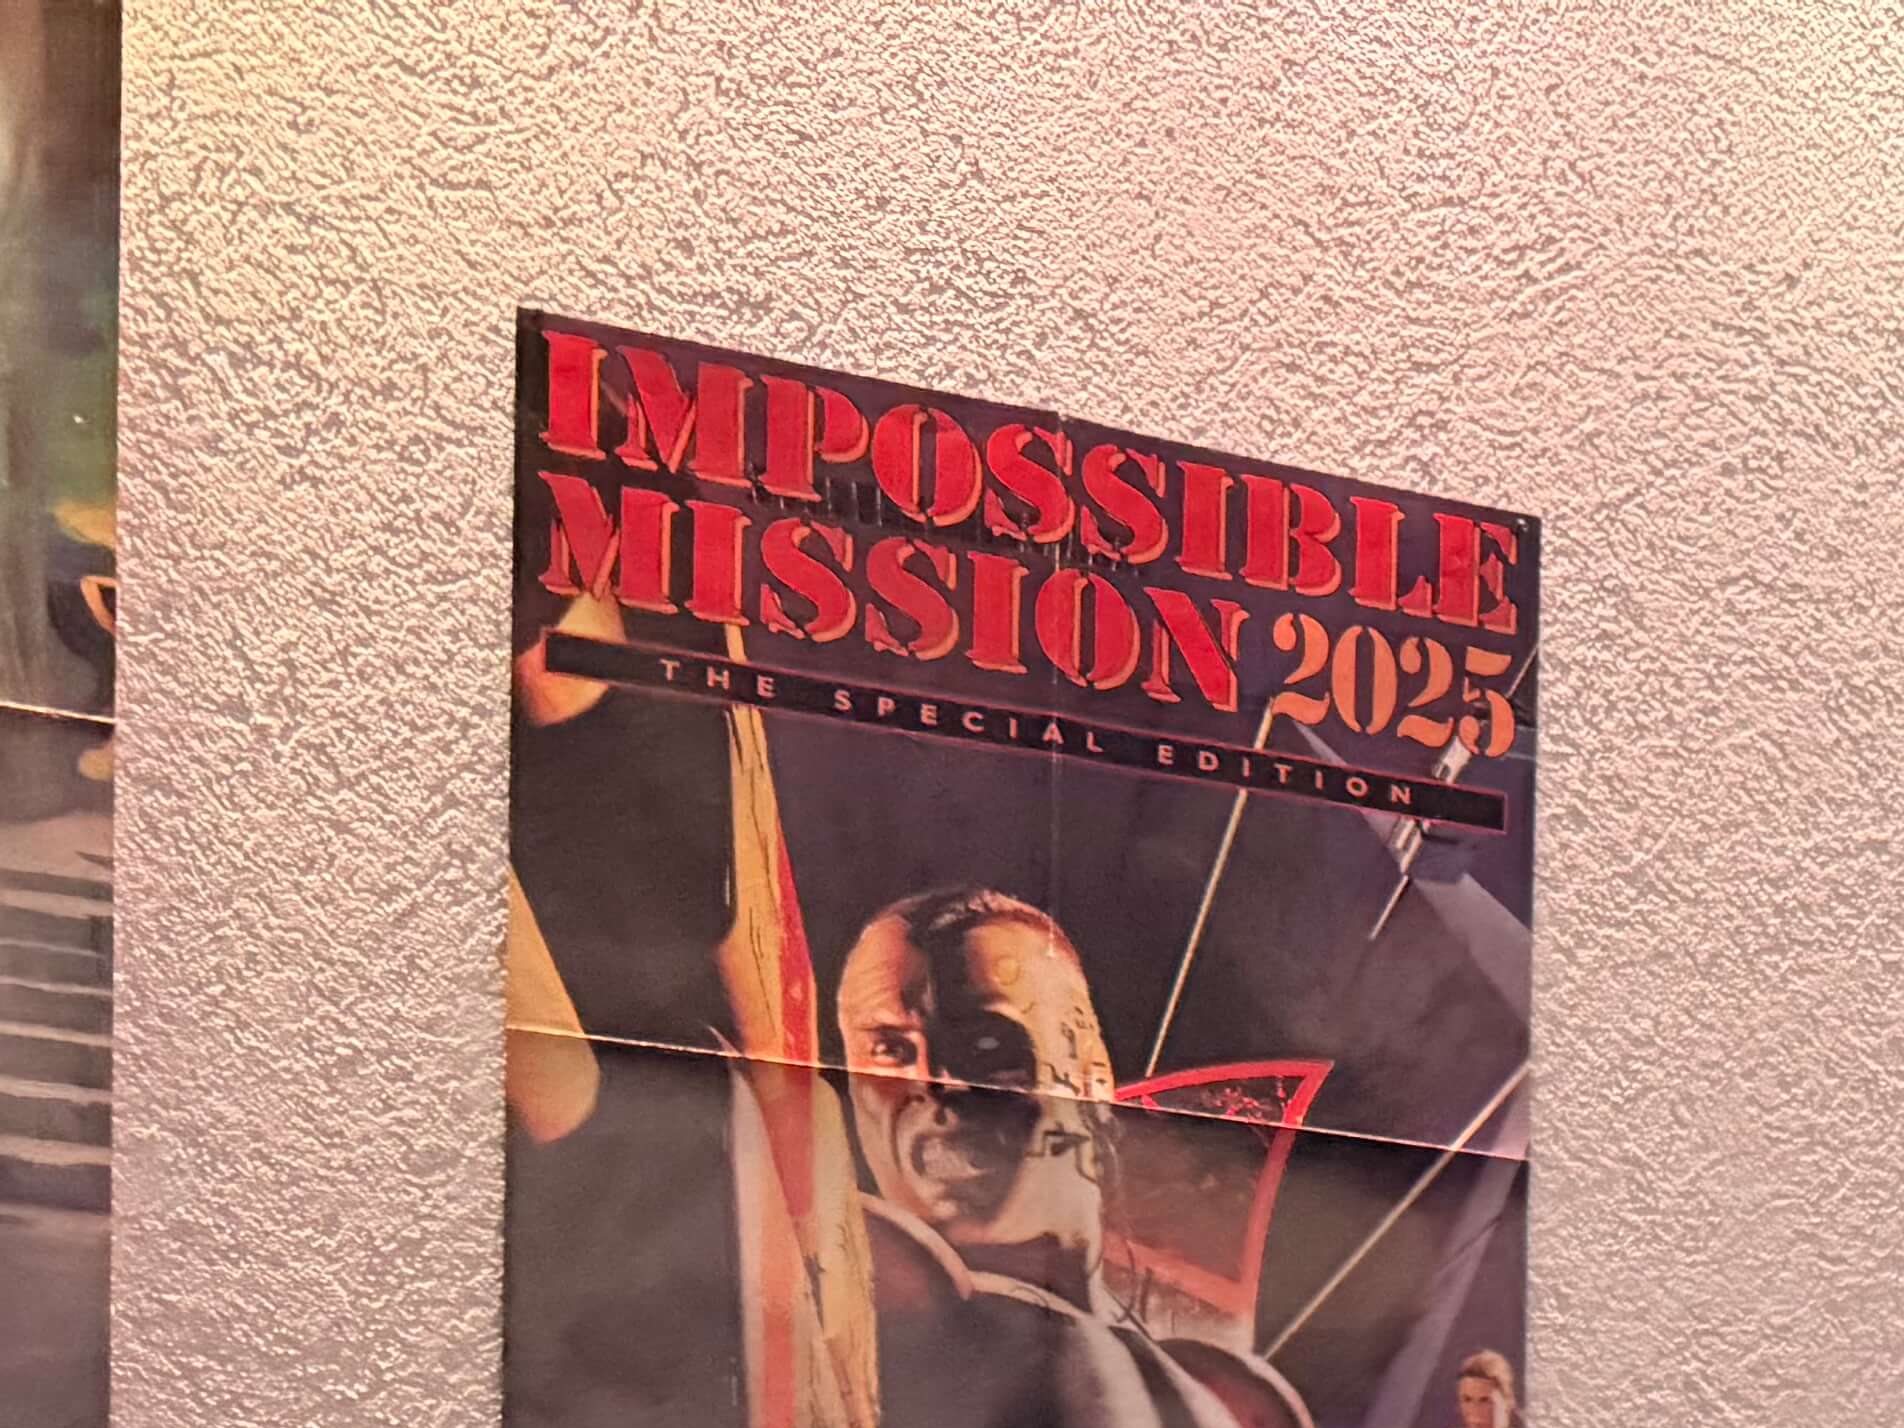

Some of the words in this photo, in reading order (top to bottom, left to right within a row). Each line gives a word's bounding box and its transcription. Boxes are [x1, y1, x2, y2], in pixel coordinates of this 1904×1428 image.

[537, 470, 1248, 711] MISSION
[1269, 611, 1514, 758] 2025
[538, 329, 1518, 634] IMPOSSIBLE
[661, 657, 775, 699] THE
[835, 690, 1103, 754] SPECIAL
[1157, 743, 1413, 805] EDITION
